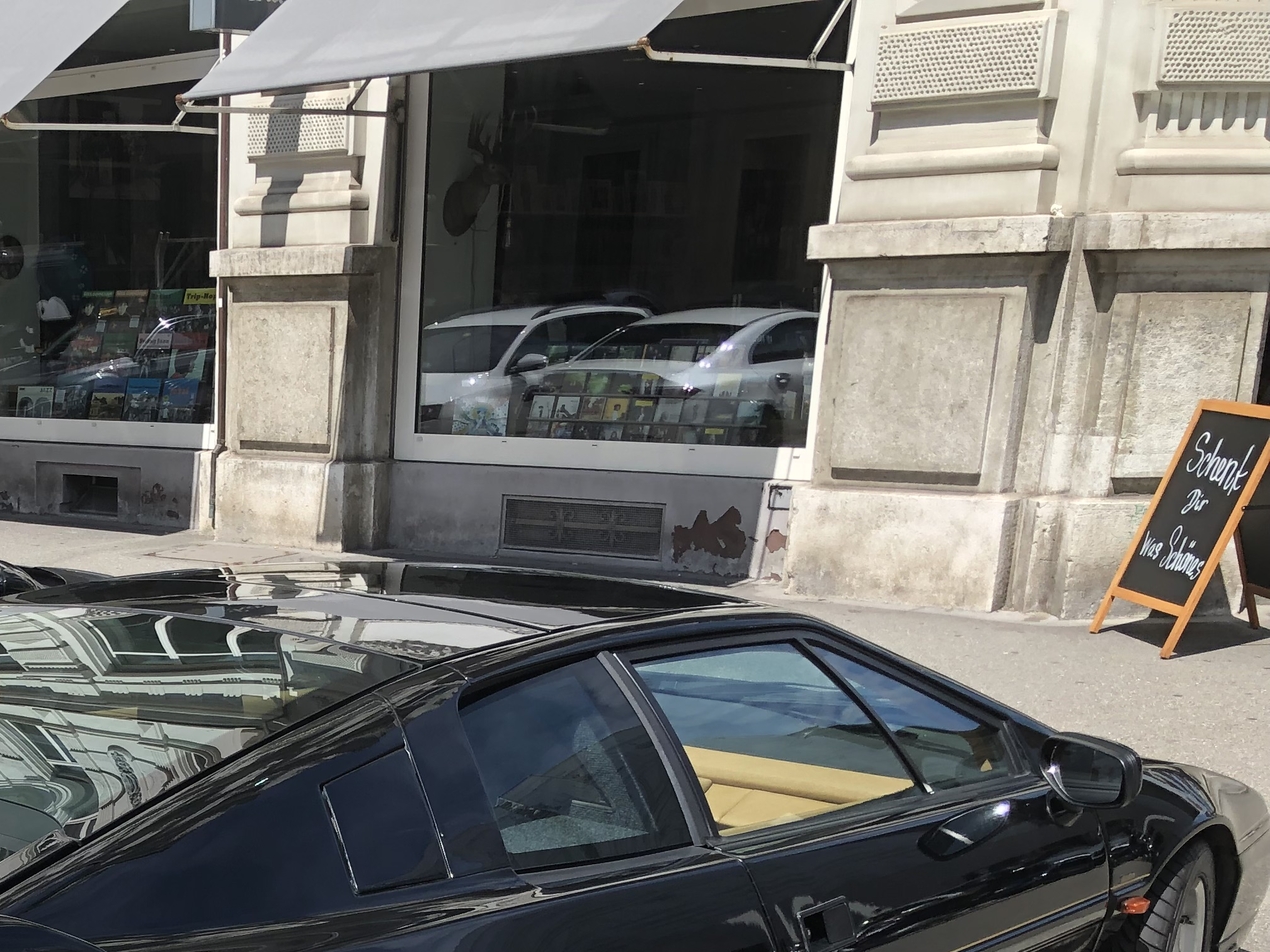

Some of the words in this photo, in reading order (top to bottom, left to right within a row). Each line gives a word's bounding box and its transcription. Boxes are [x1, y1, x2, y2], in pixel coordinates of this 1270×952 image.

[1186, 431, 1256, 496] Schenk
[1180, 488, 1210, 515] Dir
[1158, 525, 1206, 581] Schönes
